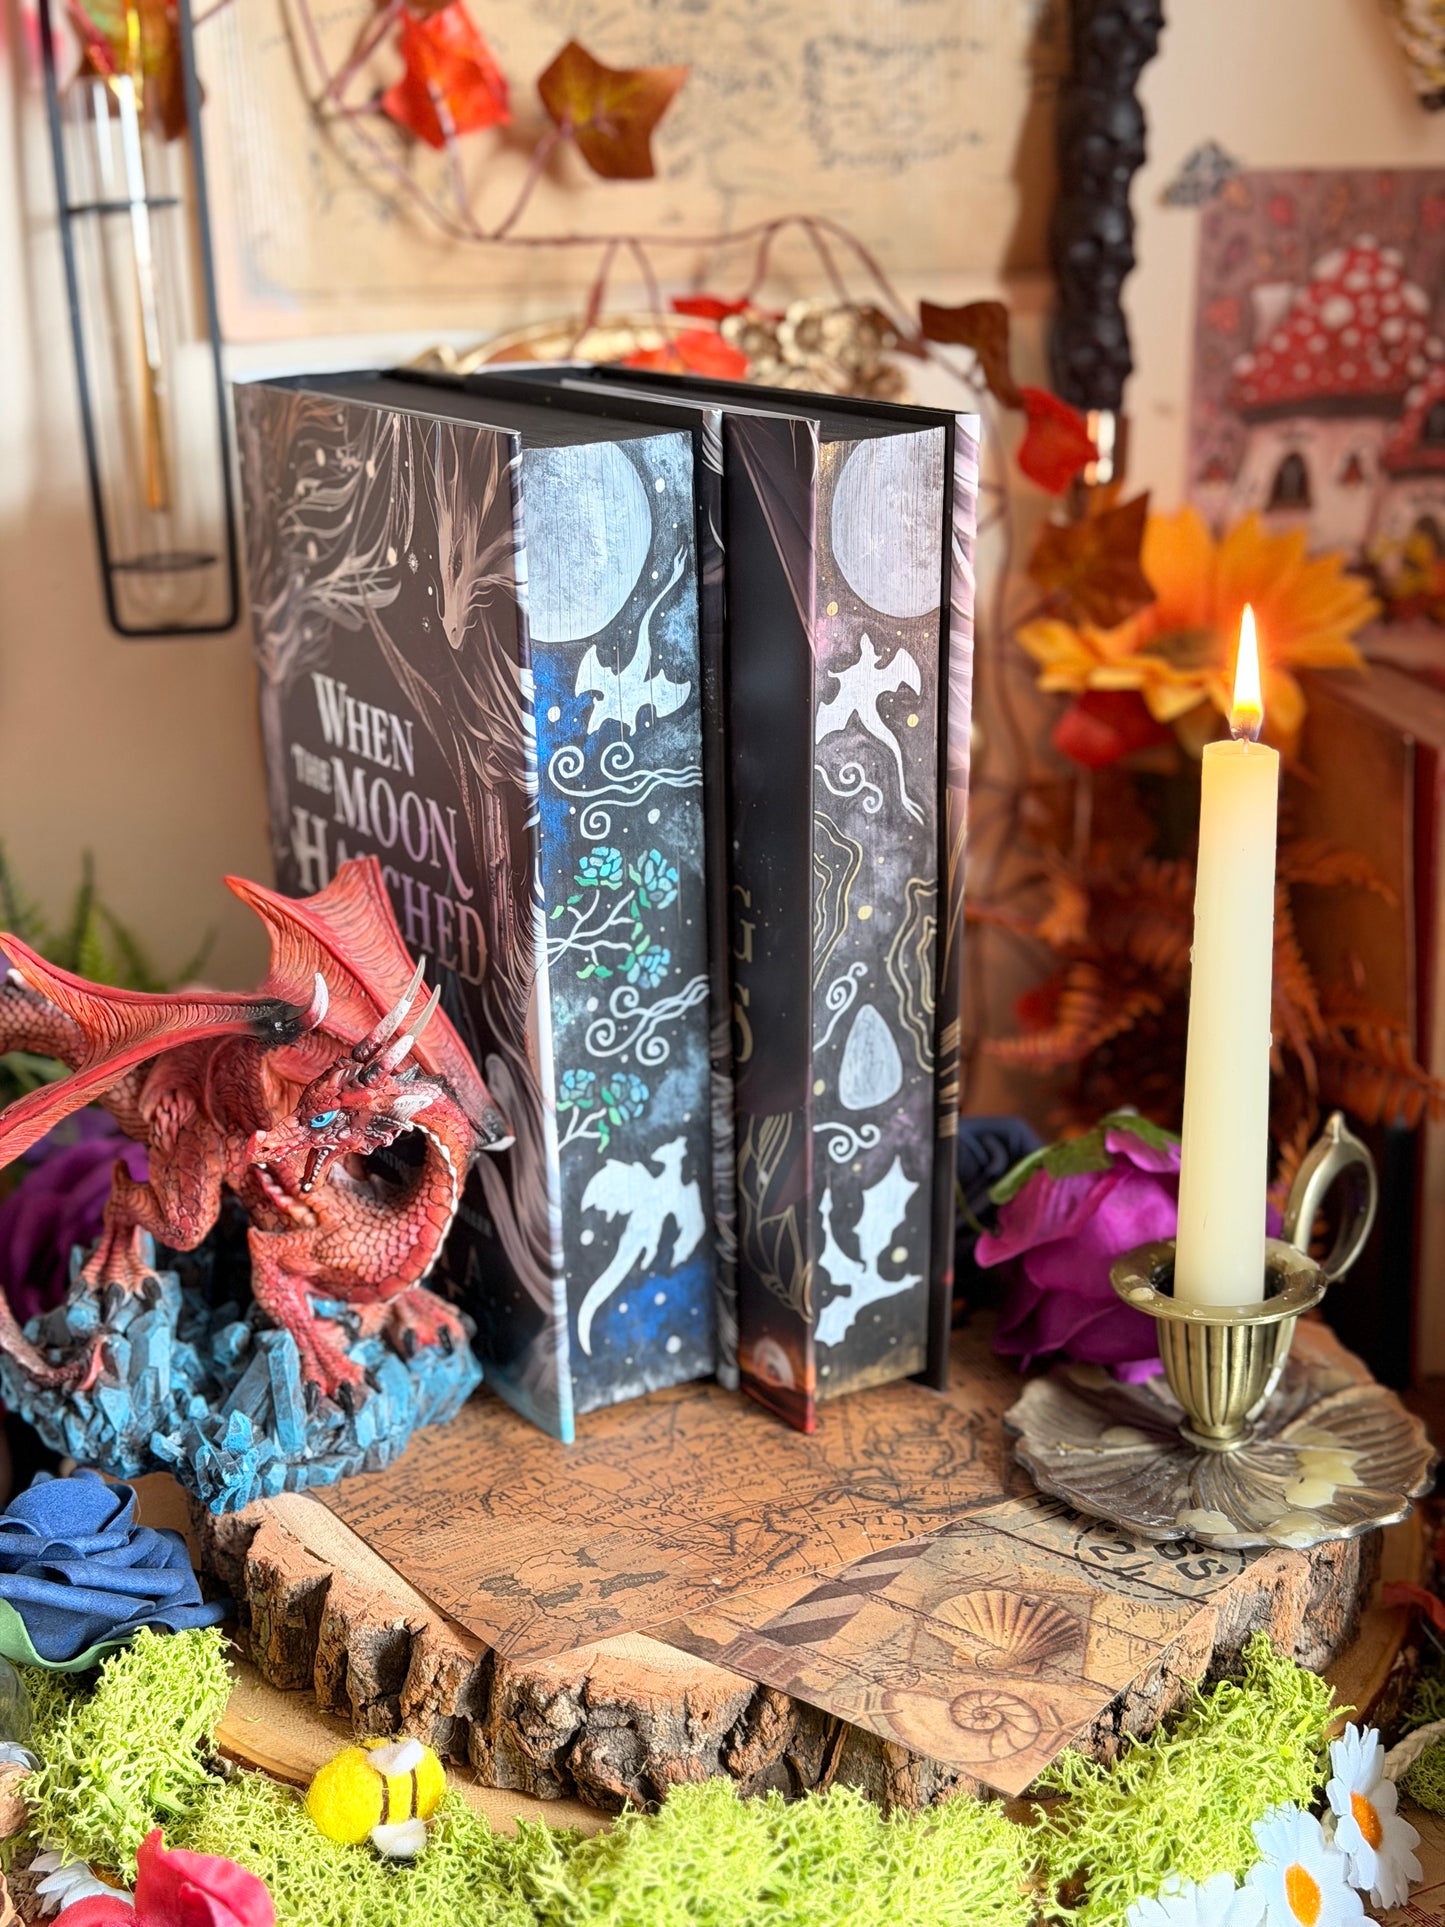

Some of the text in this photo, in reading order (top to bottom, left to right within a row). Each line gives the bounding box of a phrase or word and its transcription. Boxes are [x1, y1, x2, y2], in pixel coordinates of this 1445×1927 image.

[311, 671, 414, 777] WHEN
[291, 743, 473, 900] THE MOON
[291, 806, 487, 986] HHED
